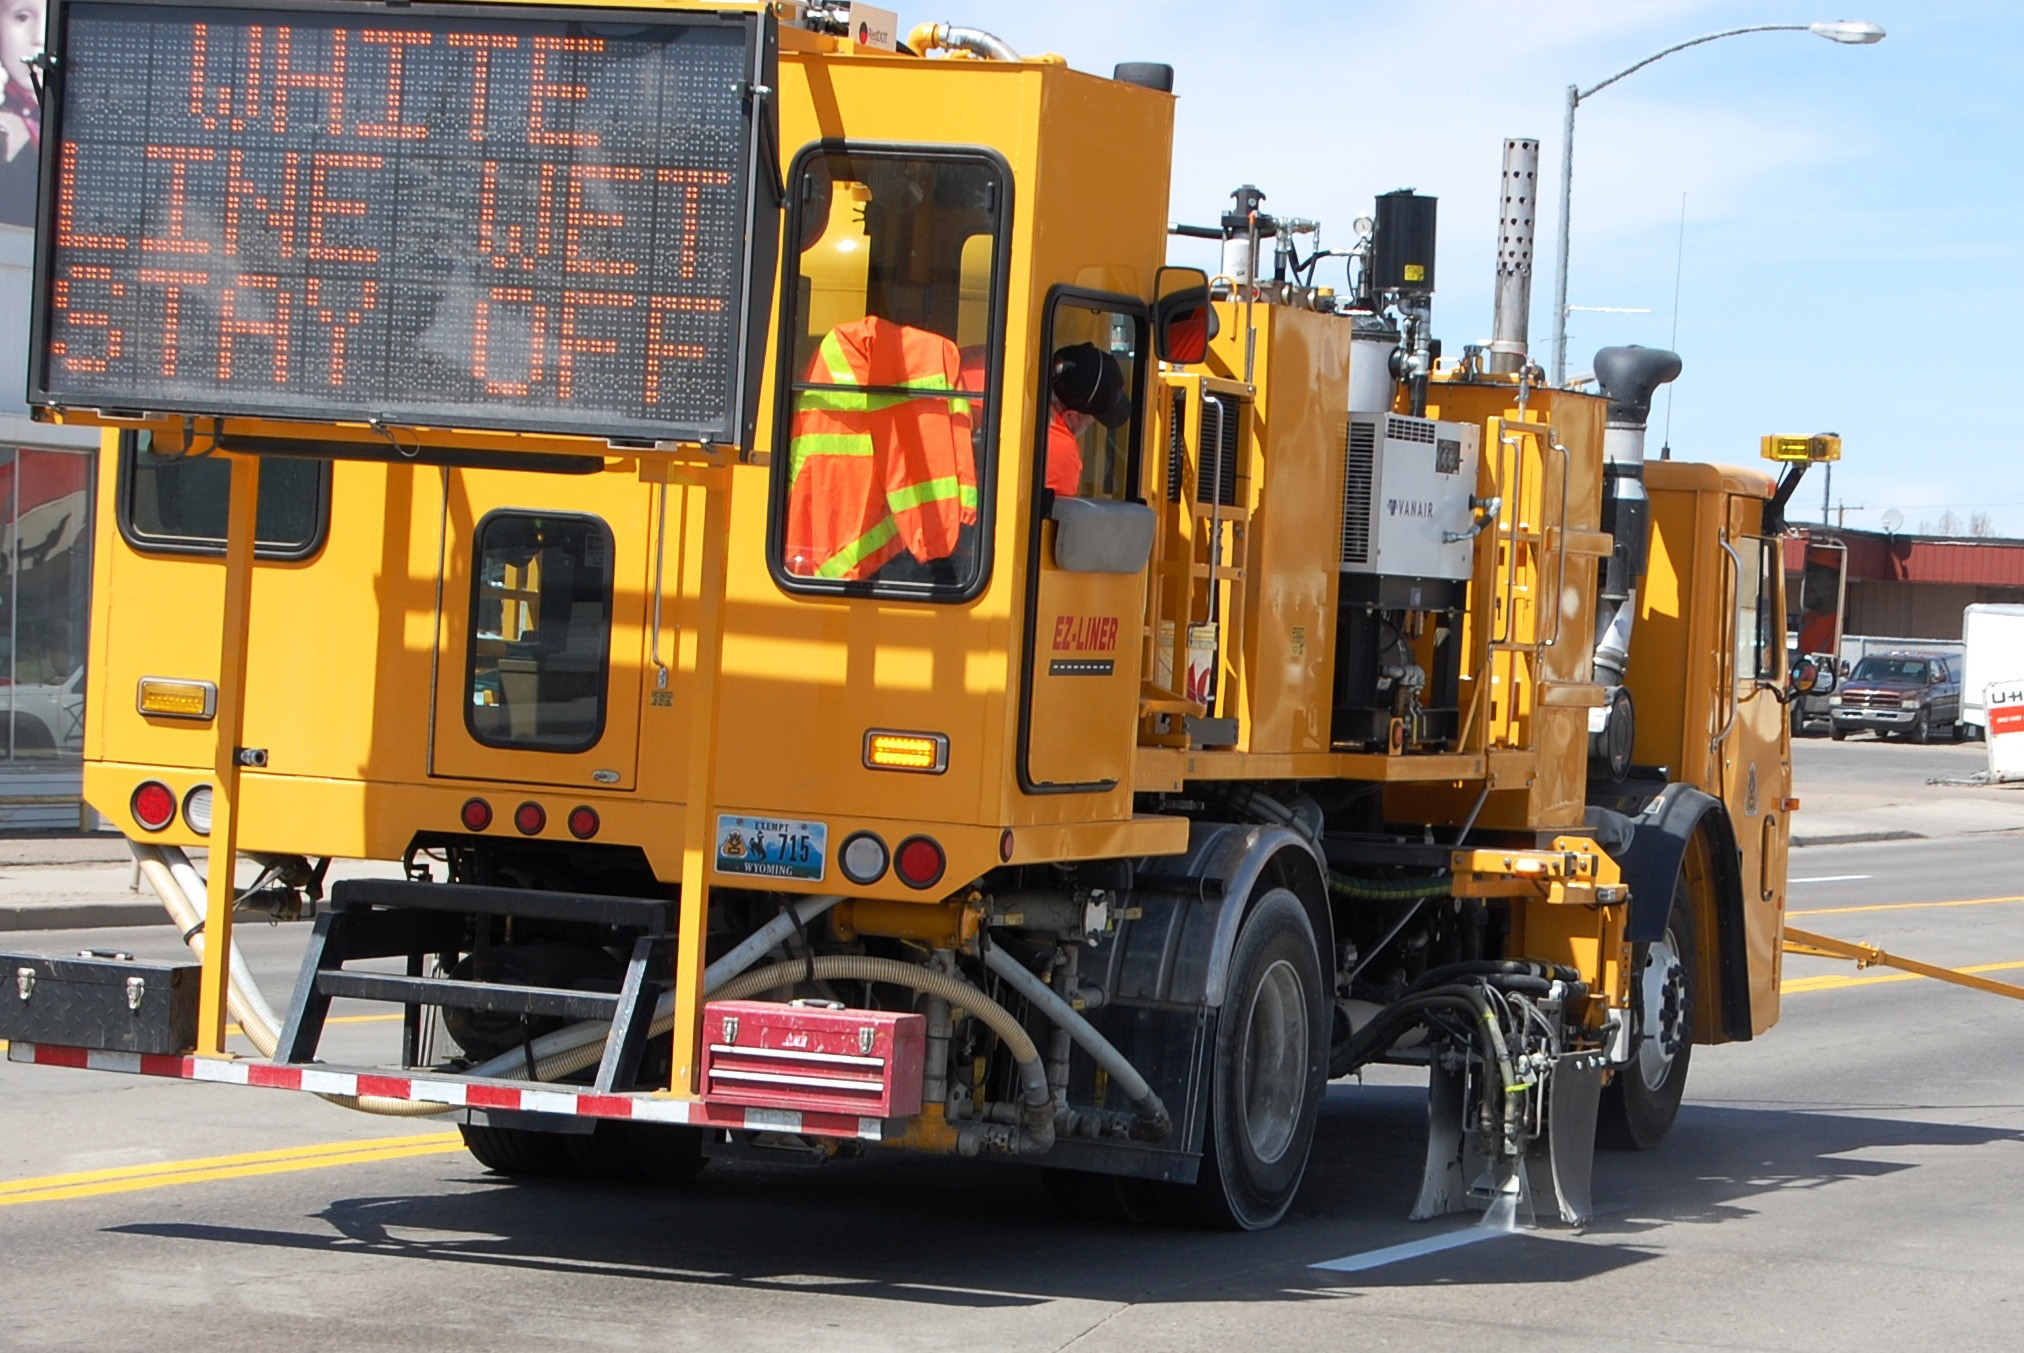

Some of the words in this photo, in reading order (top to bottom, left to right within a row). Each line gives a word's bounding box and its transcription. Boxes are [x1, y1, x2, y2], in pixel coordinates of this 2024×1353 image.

[192, 24, 603, 146] WHITE
[56, 142, 383, 262] LINE
[479, 160, 729, 279] WET
[51, 266, 376, 385] STAY
[472, 288, 722, 403] OFF
[1399, 500, 1433, 518] VANAIR
[1052, 616, 1119, 650] EZ-LINER
[755, 821, 789, 832] EXEMPT
[779, 833, 810, 863] 715
[744, 862, 793, 876] WYOMING
